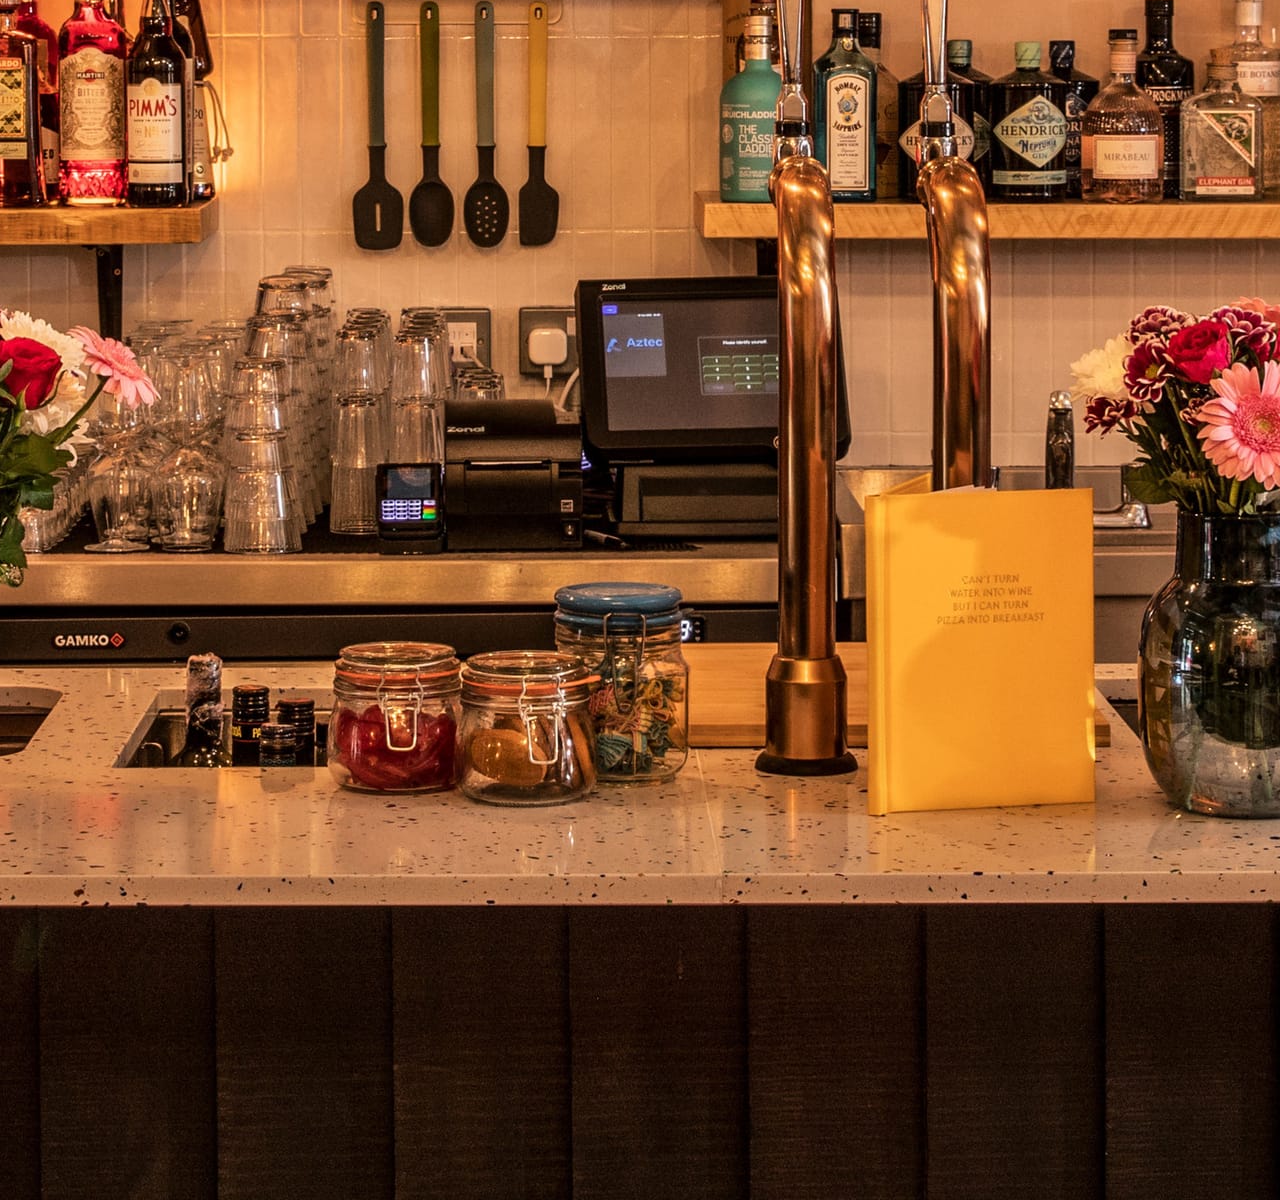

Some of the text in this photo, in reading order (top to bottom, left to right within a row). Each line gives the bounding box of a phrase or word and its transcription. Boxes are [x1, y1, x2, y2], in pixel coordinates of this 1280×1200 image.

[834, 81, 862, 94] BOMBAY
[1145, 88, 1193, 102] BROCKMAN
[129, 95, 177, 117] PIMM'S
[723, 111, 777, 119] BRUICHLADDI
[738, 124, 758, 134] THE
[832, 120, 863, 132] SAPPHIRE
[1000, 125, 1065, 136] HENDRICK
[738, 134, 774, 144] CLASSI
[738, 143, 774, 153] LADDIE
[1103, 153, 1150, 161] MIRABEAU
[1199, 178, 1252, 186] ELEPHANT GIN
[601, 283, 626, 291] Zonal
[626, 337, 663, 348] Aztec
[446, 425, 486, 433] Zonal
[961, 574, 1020, 585] CAN'T TURN
[950, 586, 1033, 598] WATER INTO WINE
[953, 600, 1029, 611] BUT CAN TURN
[936, 612, 1045, 625] PIZZA INTO BREAKFAST
[54, 634, 109, 647] GAMKO
